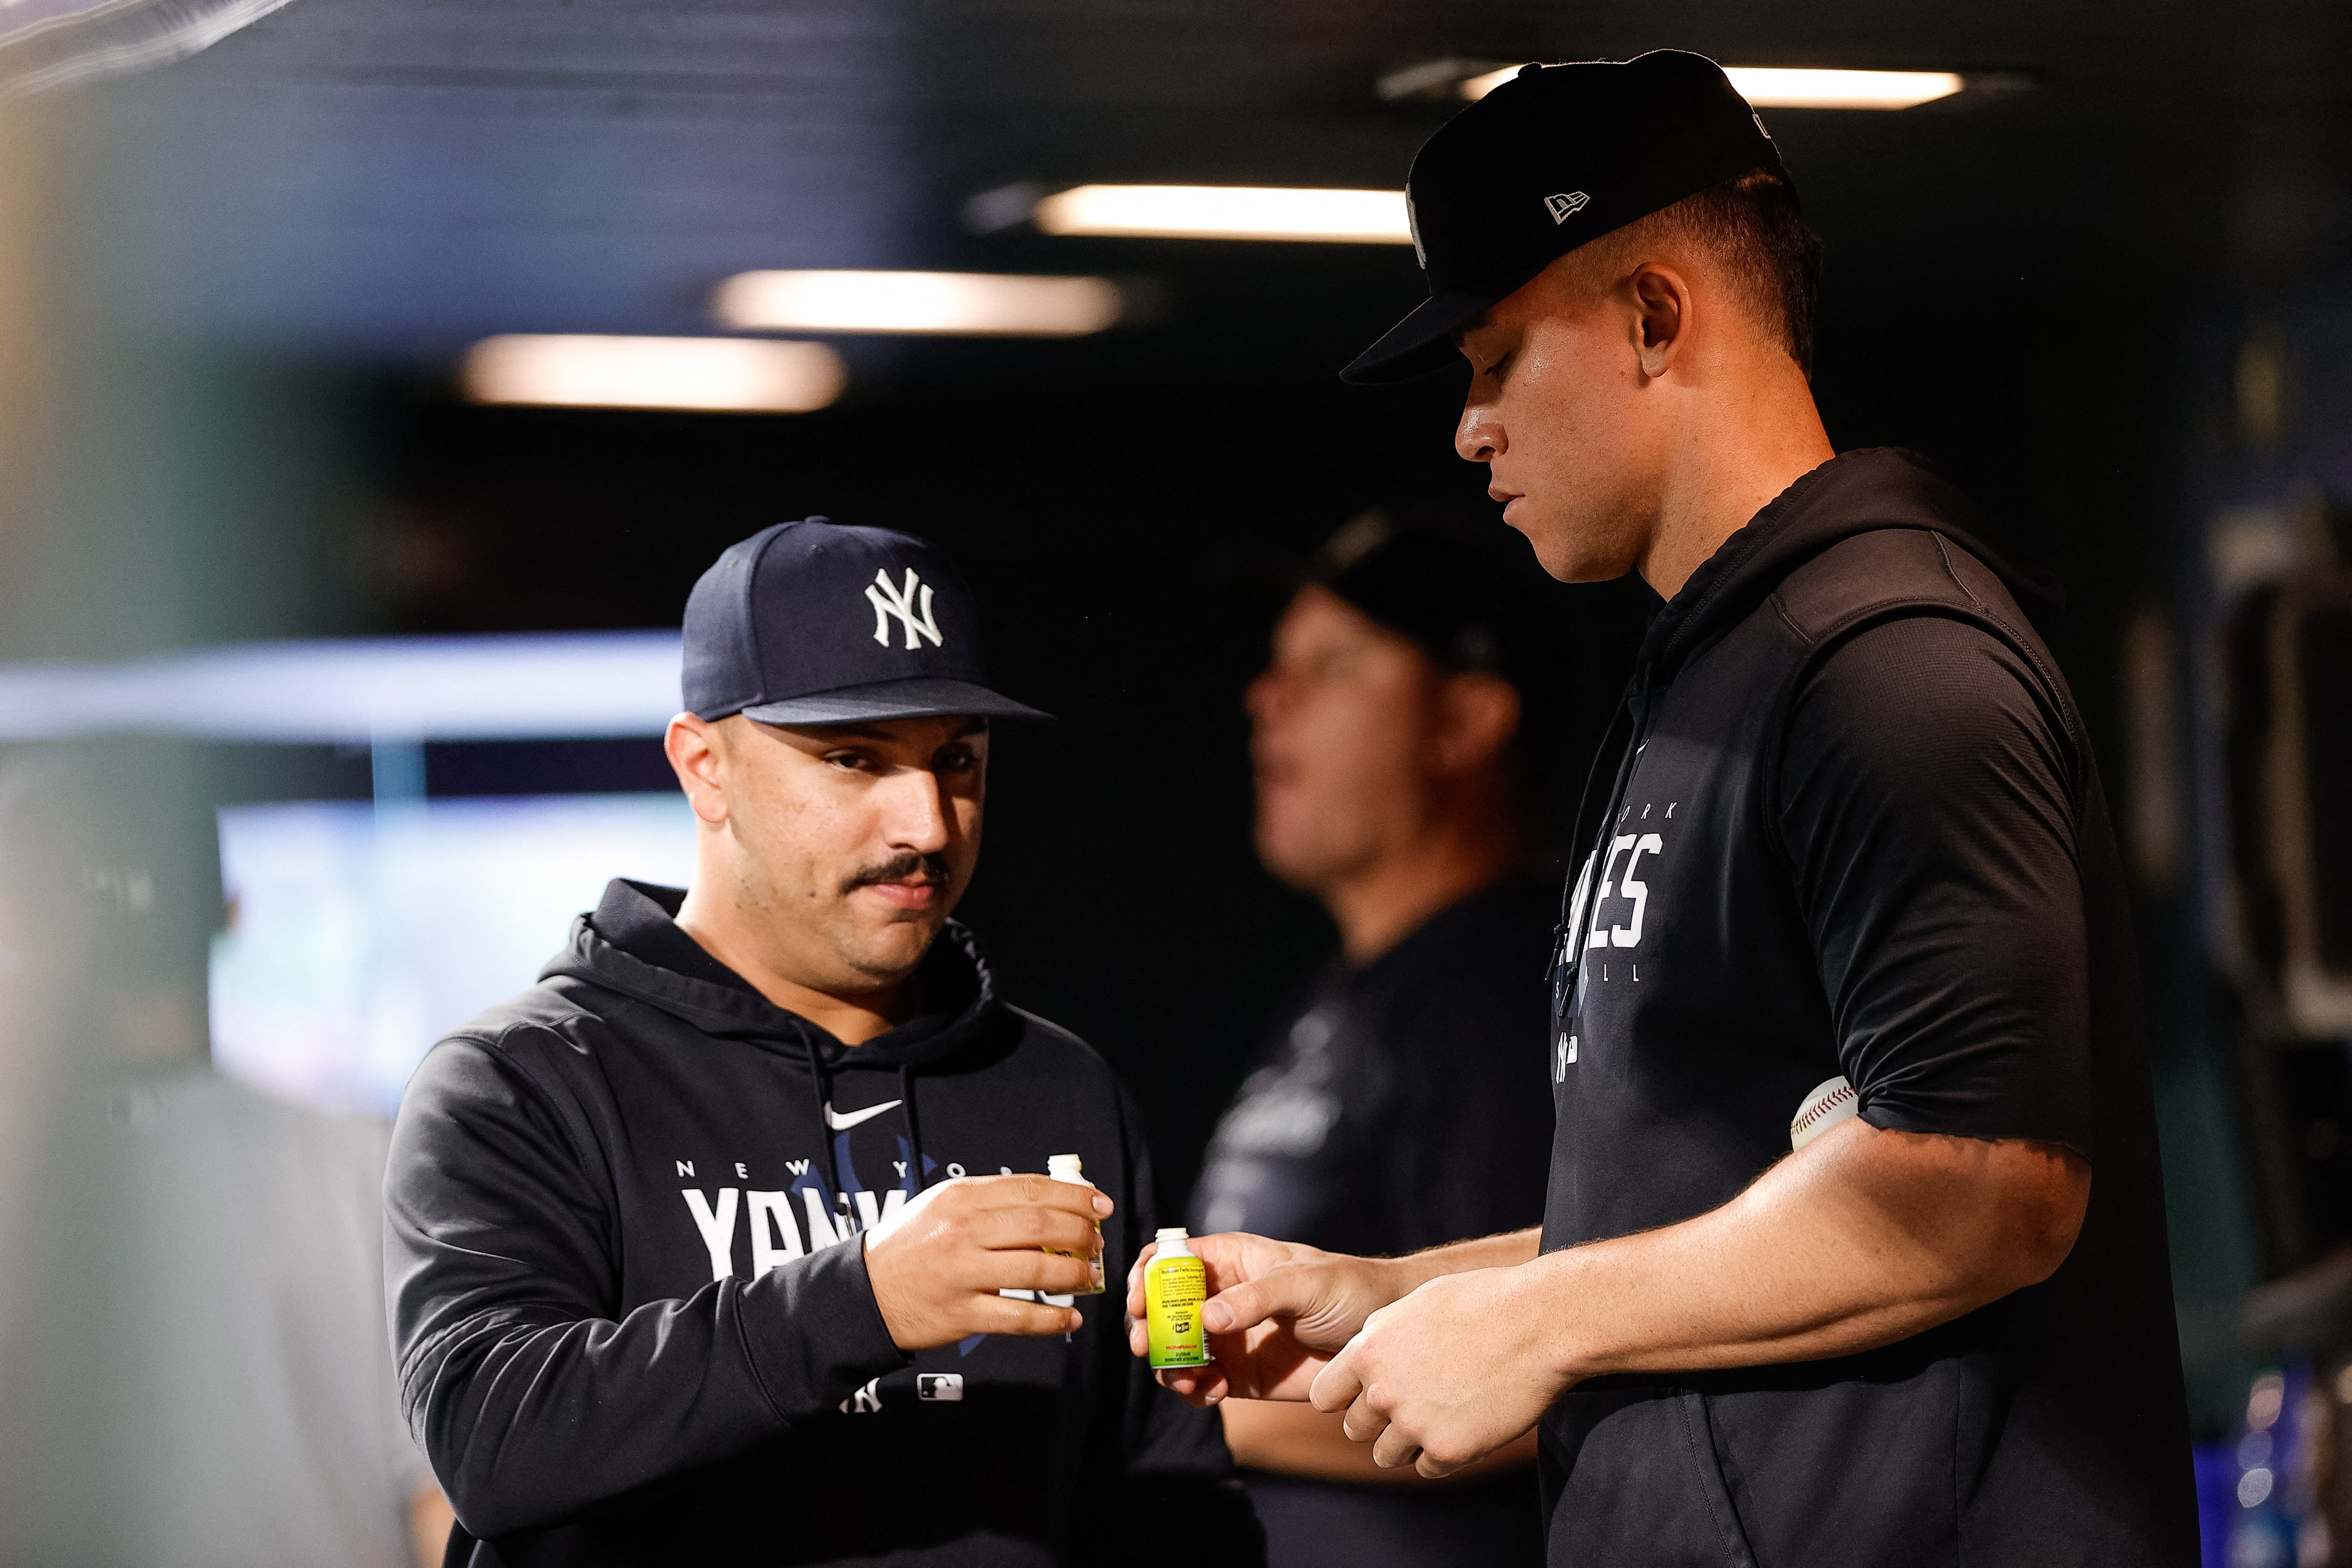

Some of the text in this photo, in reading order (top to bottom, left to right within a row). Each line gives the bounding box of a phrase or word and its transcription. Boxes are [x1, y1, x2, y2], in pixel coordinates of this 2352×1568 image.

[864, 567, 944, 650] NY
[1616, 801, 1678, 823] ORK
[675, 1158, 811, 1179] NEW
